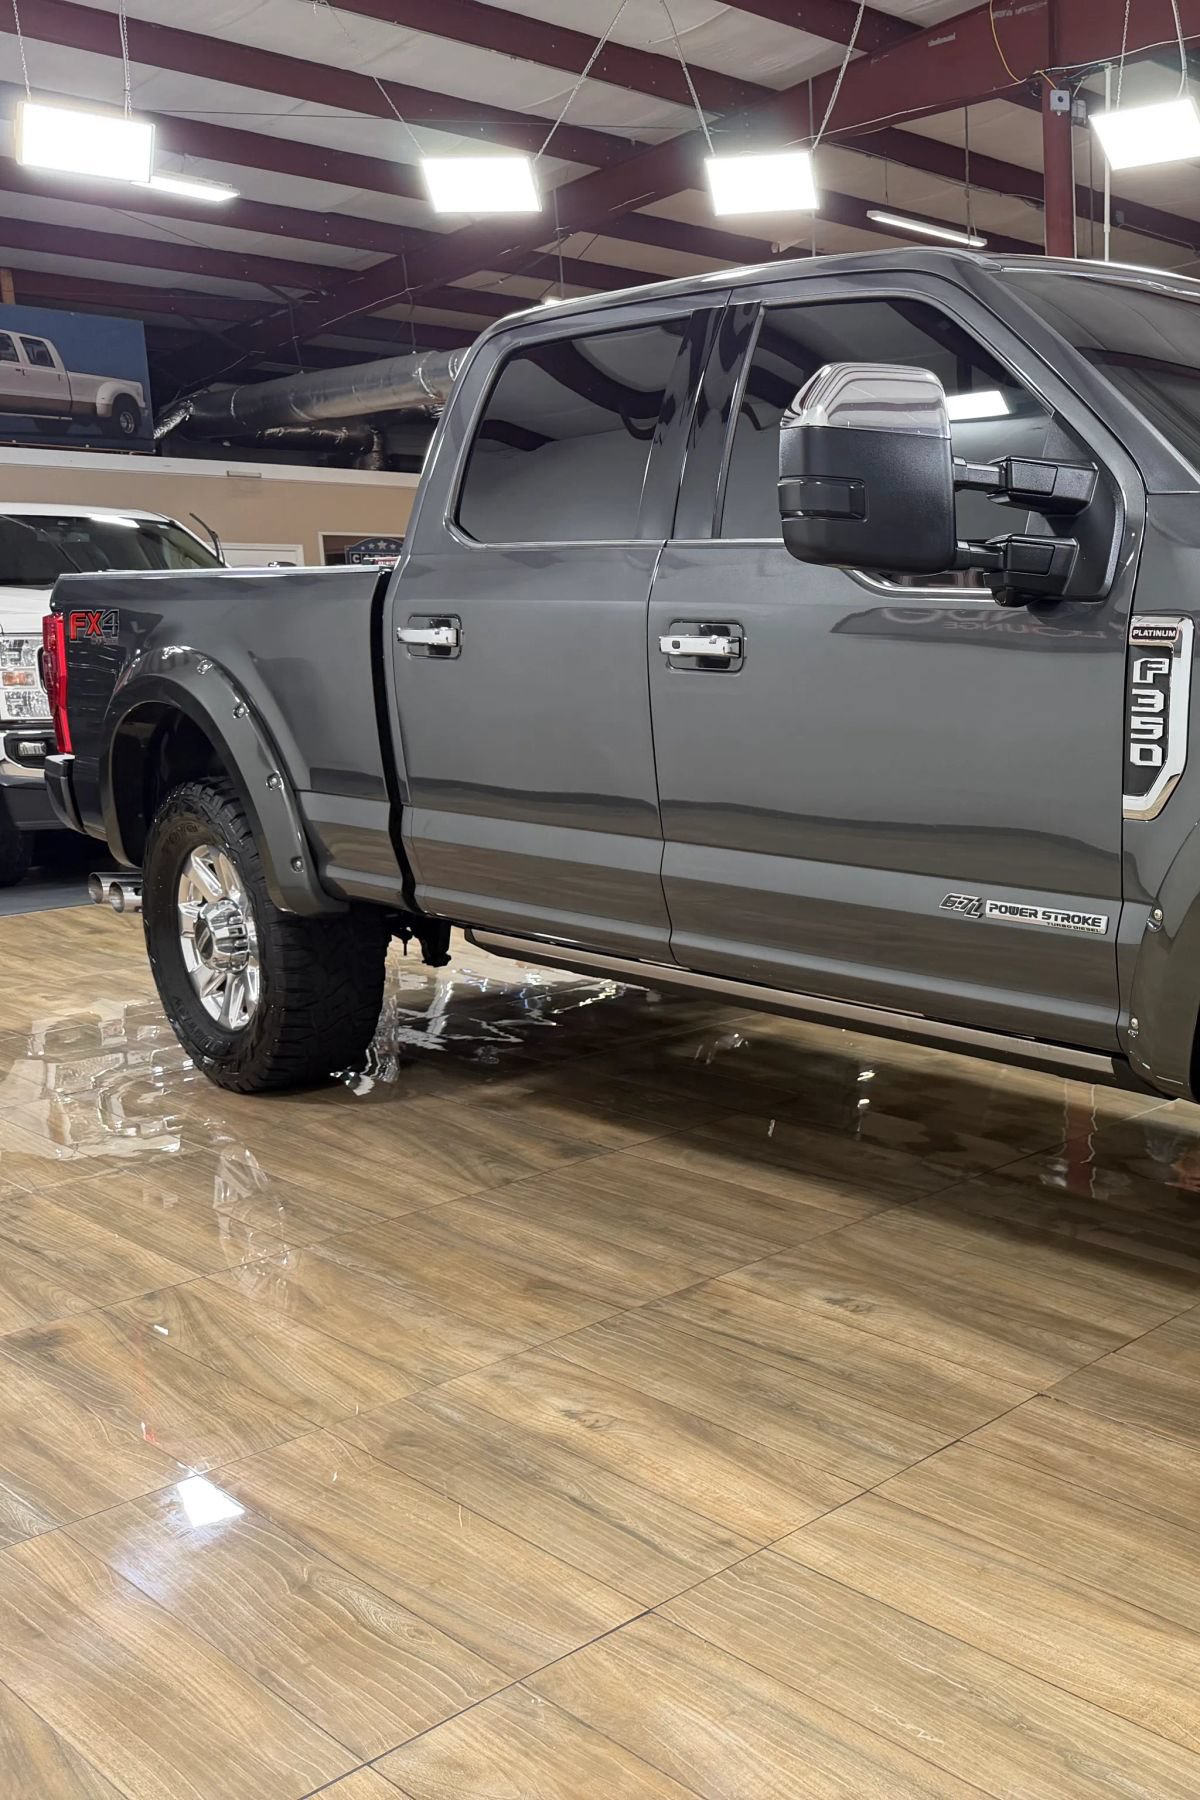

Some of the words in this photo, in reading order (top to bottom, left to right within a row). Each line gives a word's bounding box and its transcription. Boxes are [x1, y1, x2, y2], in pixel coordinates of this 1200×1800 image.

[69, 609, 120, 643] FX4
[1132, 628, 1177, 638] PLATINUM
[1129, 657, 1170, 767] F350
[938, 892, 985, 919] 6.7L
[988, 902, 1039, 919] POWER
[1041, 911, 1103, 928] STROKE
[1046, 922, 1072, 930] TURBO
[1073, 925, 1100, 933] DIESEL
